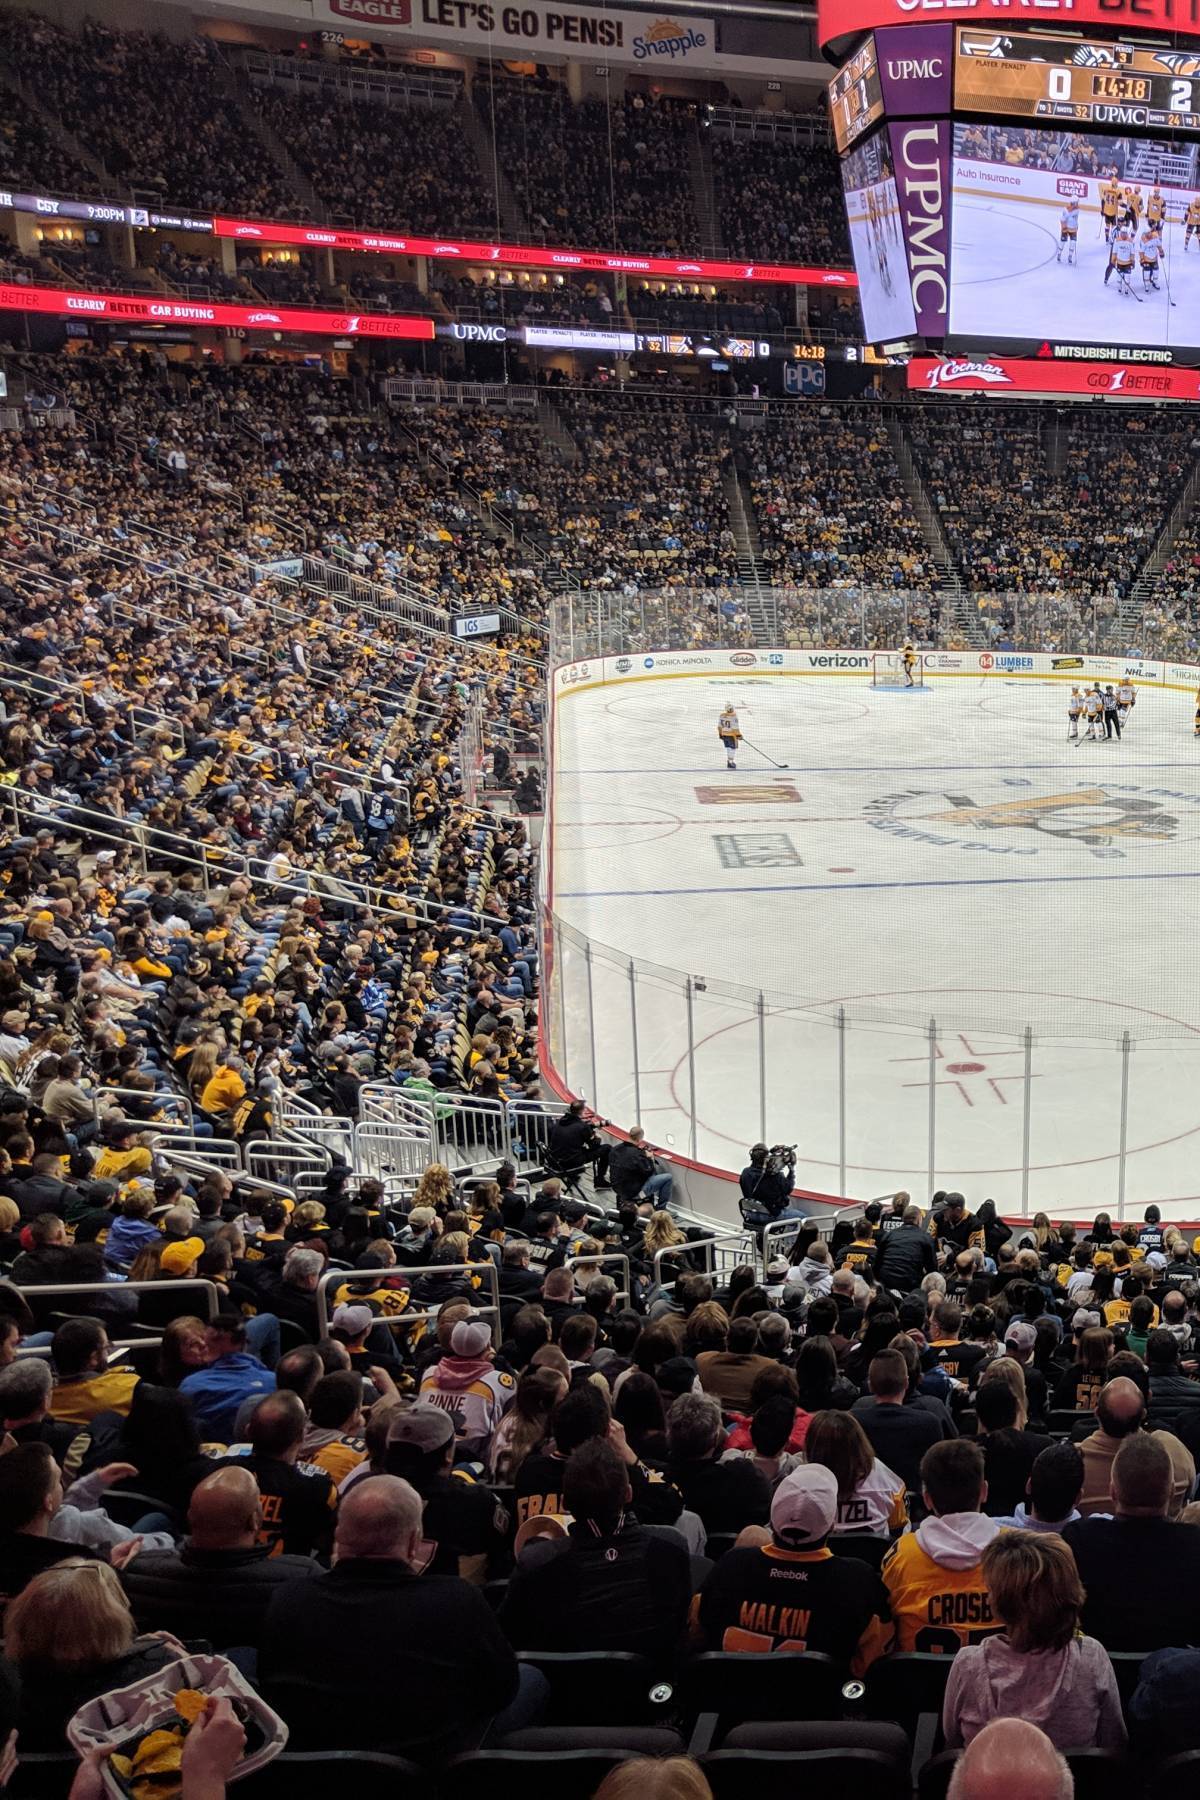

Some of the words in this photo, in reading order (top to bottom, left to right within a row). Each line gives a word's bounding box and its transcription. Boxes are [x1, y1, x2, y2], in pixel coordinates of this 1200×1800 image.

[423, 0, 495, 32] LET'S
[502, 7, 540, 38] GO
[545, 13, 624, 48] PENS!
[321, 32, 344, 44] 226
[633, 28, 707, 59] Snapple
[1119, 53, 1127, 63] 3
[888, 59, 943, 80] UPMC
[1049, 68, 1072, 100] 0
[1097, 77, 1146, 98] 14:18
[1170, 80, 1192, 112] 2
[1074, 105, 1088, 117] 32
[1094, 105, 1146, 125] UPMC
[1168, 113, 1180, 126] 24
[956, 167, 977, 180] Auto
[978, 169, 1021, 186] Insurance
[1059, 179, 1087, 190] GIANT
[1059, 187, 1086, 198] EAGLE
[36, 198, 60, 214] CGY
[87, 206, 125, 222] 9:00PM
[902, 123, 948, 314] UPMC
[306, 233, 336, 243] CLEARLY
[379, 240, 405, 249] BUYING
[67, 298, 106, 311] CLEARLY
[151, 305, 171, 316] CAR
[174, 307, 215, 319] BUYING
[226, 327, 245, 338] 116
[360, 319, 400, 333] BETTER
[453, 324, 507, 341] UPMC
[649, 341, 661, 351] 32
[759, 342, 770, 356] 0
[794, 345, 825, 359] 14:18
[846, 348, 857, 360] 2
[1054, 345, 1117, 360] MITSUBISHI
[1119, 349, 1172, 362] ELECTRIC
[1087, 372, 1110, 387] GO
[1125, 376, 1171, 391] BETTER
[463, 619, 478, 633] IGS
[729, 655, 757, 665] Glidden
[808, 653, 869, 668] verizon
[980, 656, 992, 667] 84
[995, 656, 1034, 667] LUMBER
[427, 1393, 467, 1412] RINNE
[769, 1567, 809, 1582] Reebok
[927, 1591, 994, 1625] CROSB
[739, 1600, 812, 1638] MALKIN
